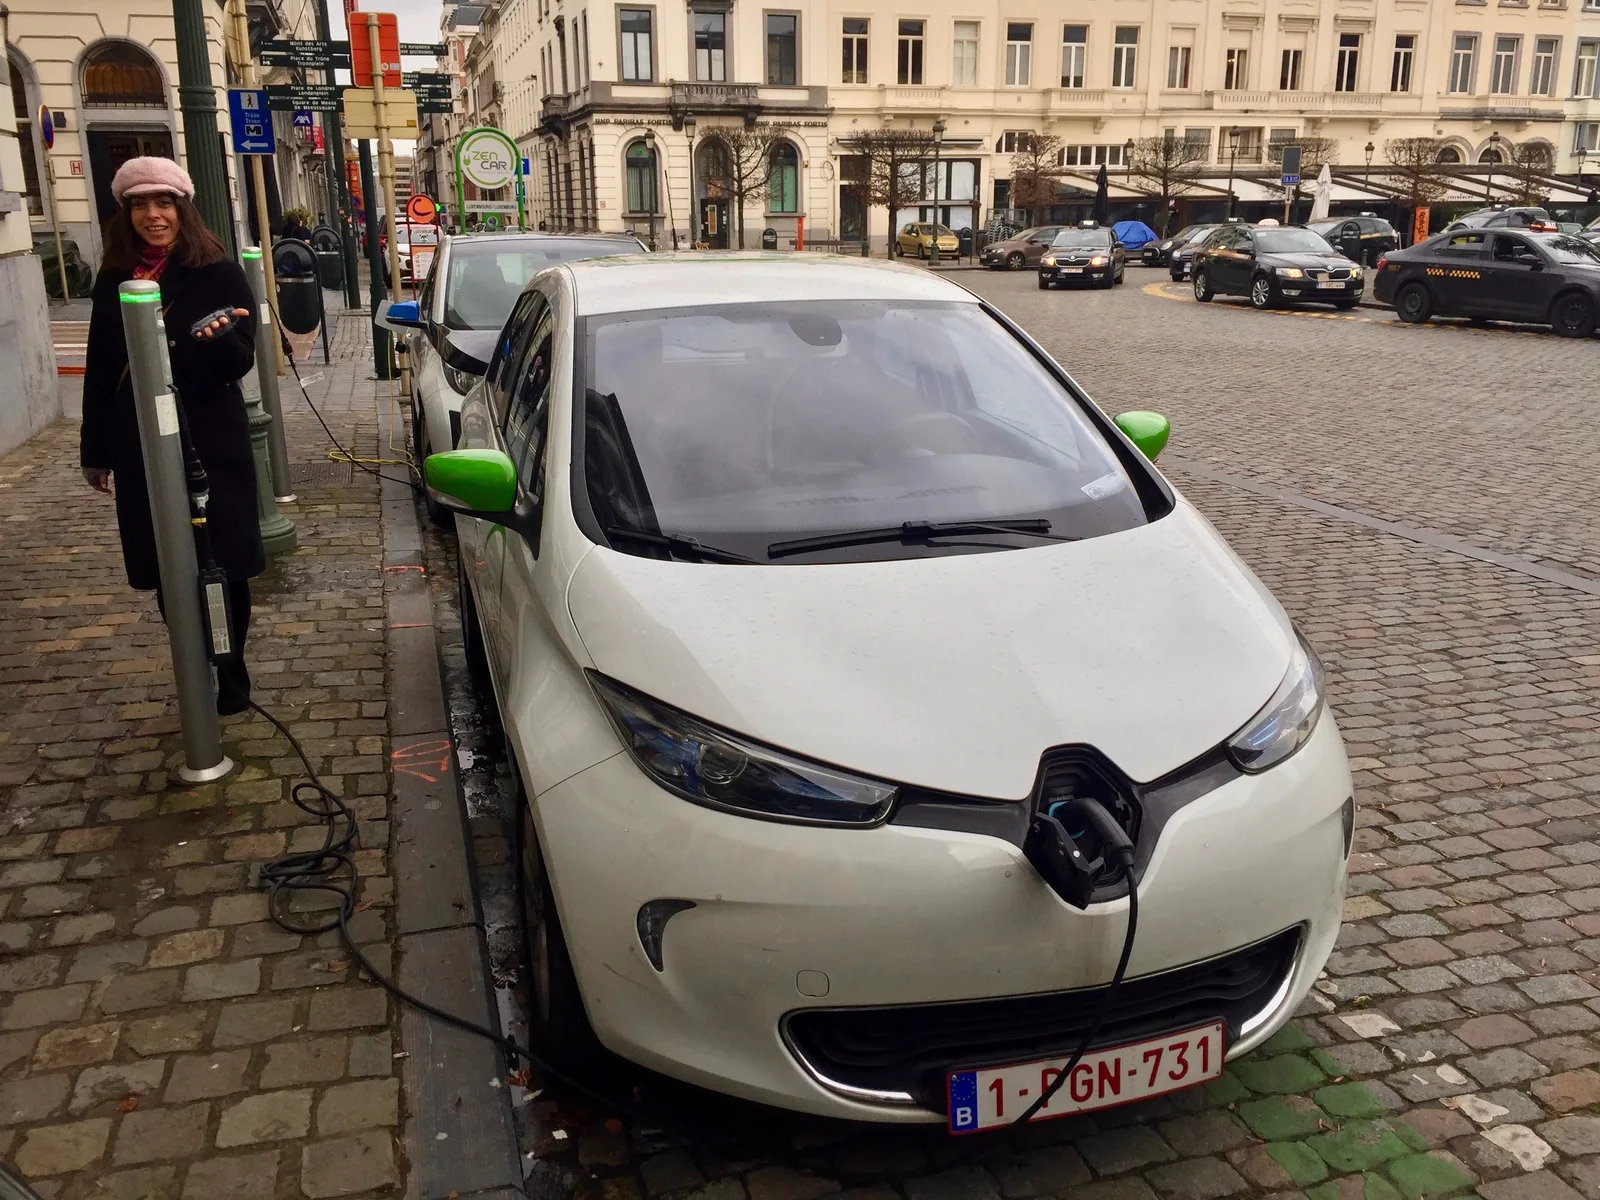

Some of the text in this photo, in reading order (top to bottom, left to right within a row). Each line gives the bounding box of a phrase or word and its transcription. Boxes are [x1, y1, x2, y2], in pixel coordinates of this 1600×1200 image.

[294, 115, 311, 124] AXA
[472, 151, 498, 161] ZEN
[481, 161, 507, 170] CAR
[1282, 175, 1298, 183] TAXIS
[956, 1106, 972, 1126] B
